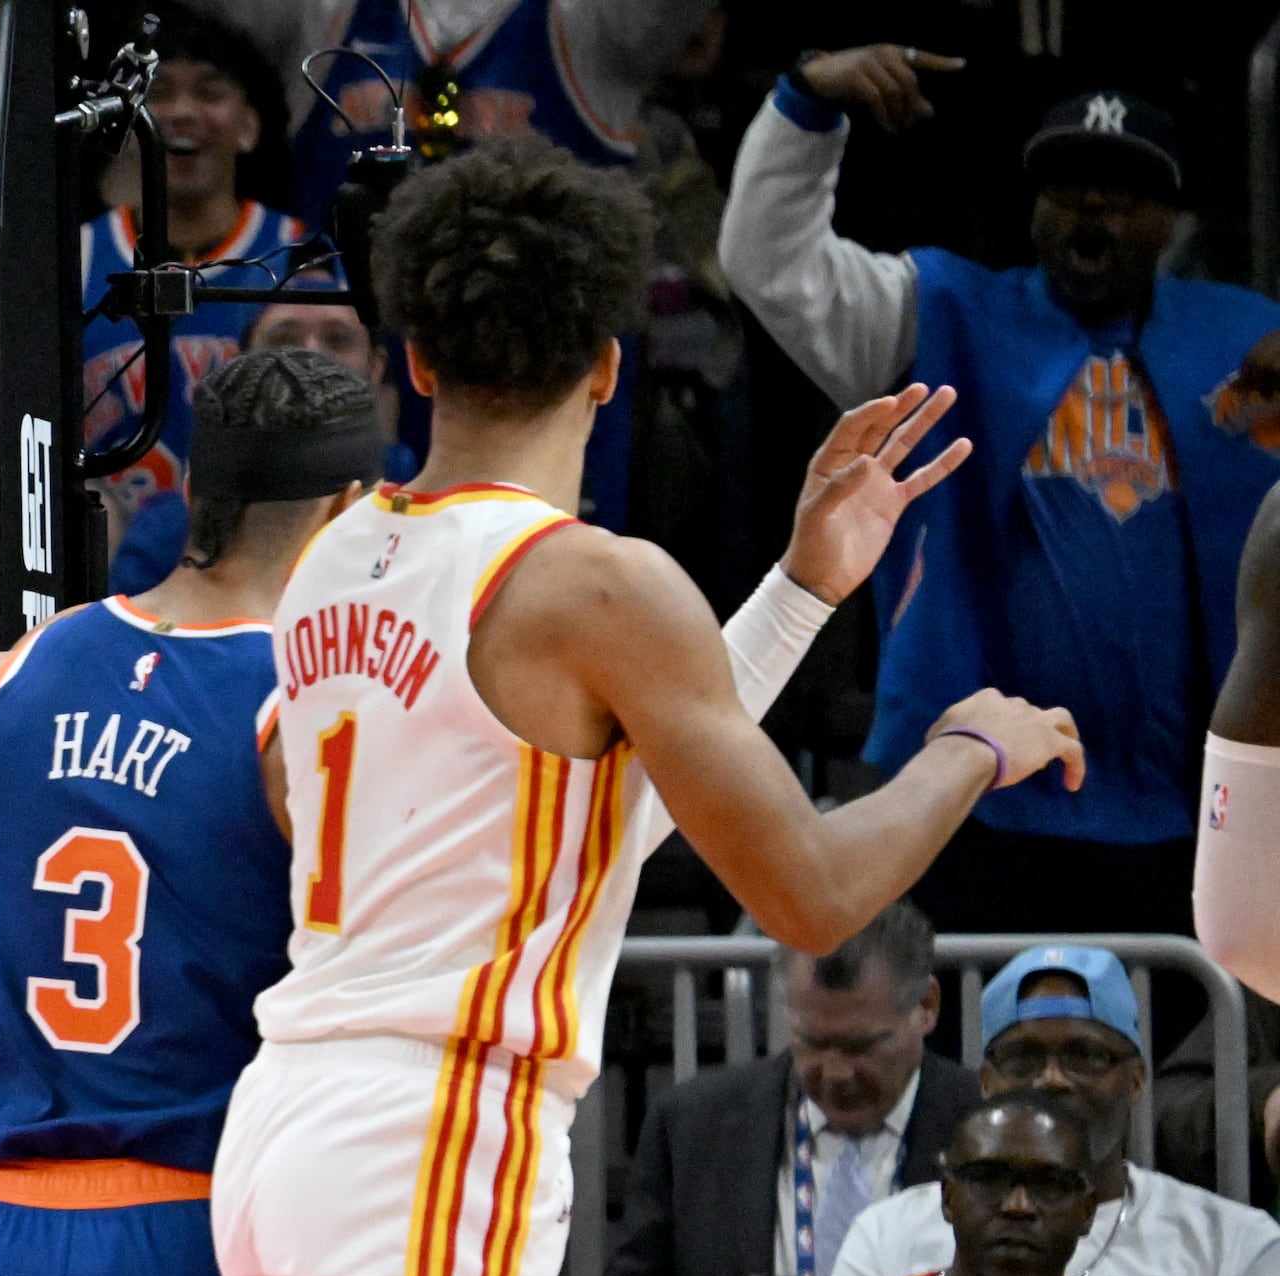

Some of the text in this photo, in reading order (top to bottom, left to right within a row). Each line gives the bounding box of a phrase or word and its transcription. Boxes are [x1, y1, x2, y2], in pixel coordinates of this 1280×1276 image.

[21, 413, 52, 574] GET
[286, 603, 440, 711] JOHNSON
[48, 711, 192, 798] HART
[304, 710, 357, 935] 1
[26, 826, 150, 1054] 3
